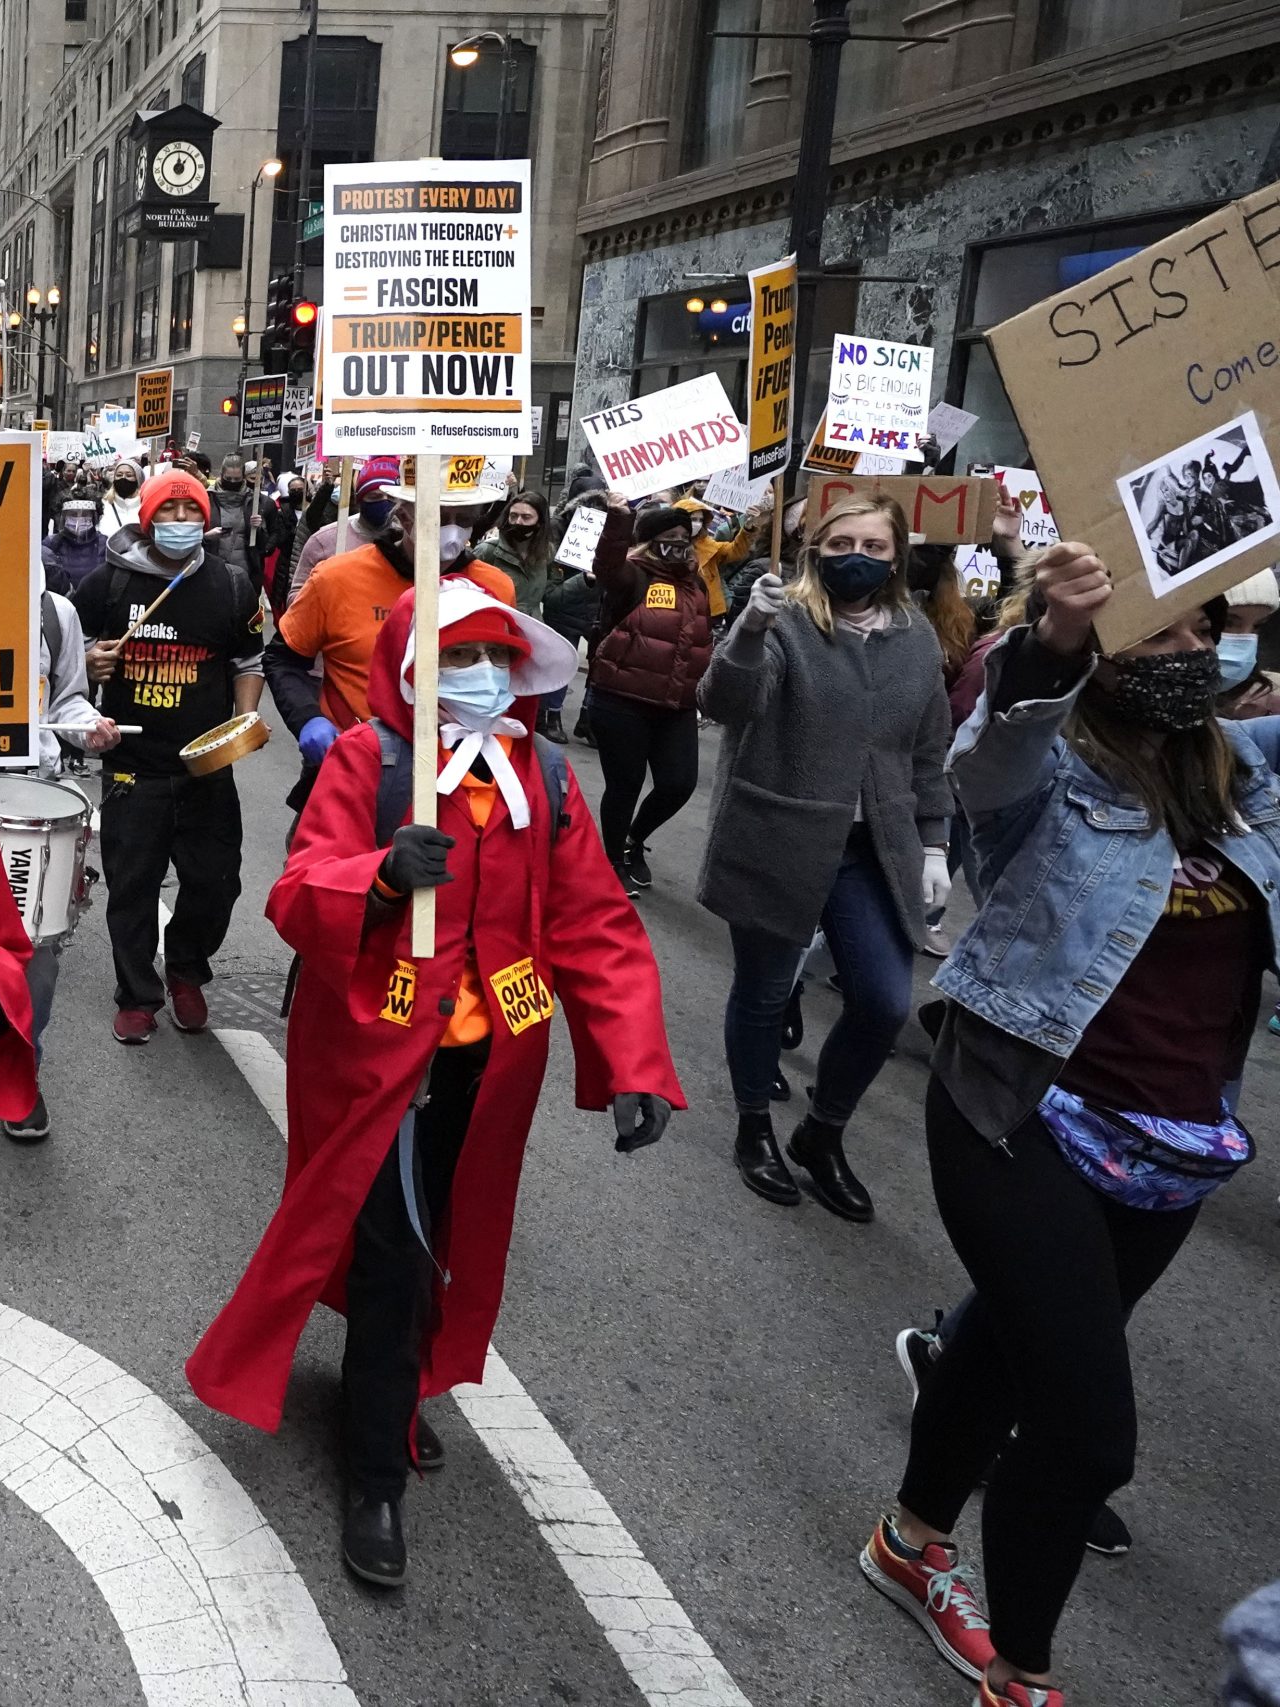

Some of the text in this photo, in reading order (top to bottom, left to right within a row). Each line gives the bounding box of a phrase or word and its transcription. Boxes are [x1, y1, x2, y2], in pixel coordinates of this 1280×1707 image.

[341, 188, 414, 210] PROTEST
[420, 188, 470, 208] EVERY
[475, 188, 515, 208] DAY!
[340, 223, 417, 243] CHRISTIAN
[335, 250, 515, 269] DESTROYING THE ELECTION
[377, 278, 478, 308] FASCISM
[348, 322, 506, 348] TRUMP/PENCE
[838, 342, 921, 372] NO SIGN
[139, 373, 170, 387] Trump/
[343, 355, 515, 397] OUT NOW!
[1187, 341, 1280, 406] Come
[141, 386, 167, 396] Pence
[838, 373, 921, 398] IS BIG ENOUGH
[144, 397, 166, 413] OUT
[138, 411, 169, 428] NOW!
[583, 403, 643, 434] THIS
[837, 409, 885, 425] ALL THE
[335, 424, 416, 438] @RefuseFascism
[430, 424, 519, 439] RefuseFascism.org
[830, 423, 865, 442] I'M
[603, 413, 740, 480] HANDMAID'S
[810, 445, 855, 465] NOW!
[455, 458, 482, 471] OUT
[648, 597, 674, 605] NOW
[124, 660, 198, 684] NOTHING
[133, 682, 182, 708] LESS!
[9, 848, 32, 917] YAMAH
[502, 972, 535, 1005] OUT
[506, 989, 549, 1028] NOW
